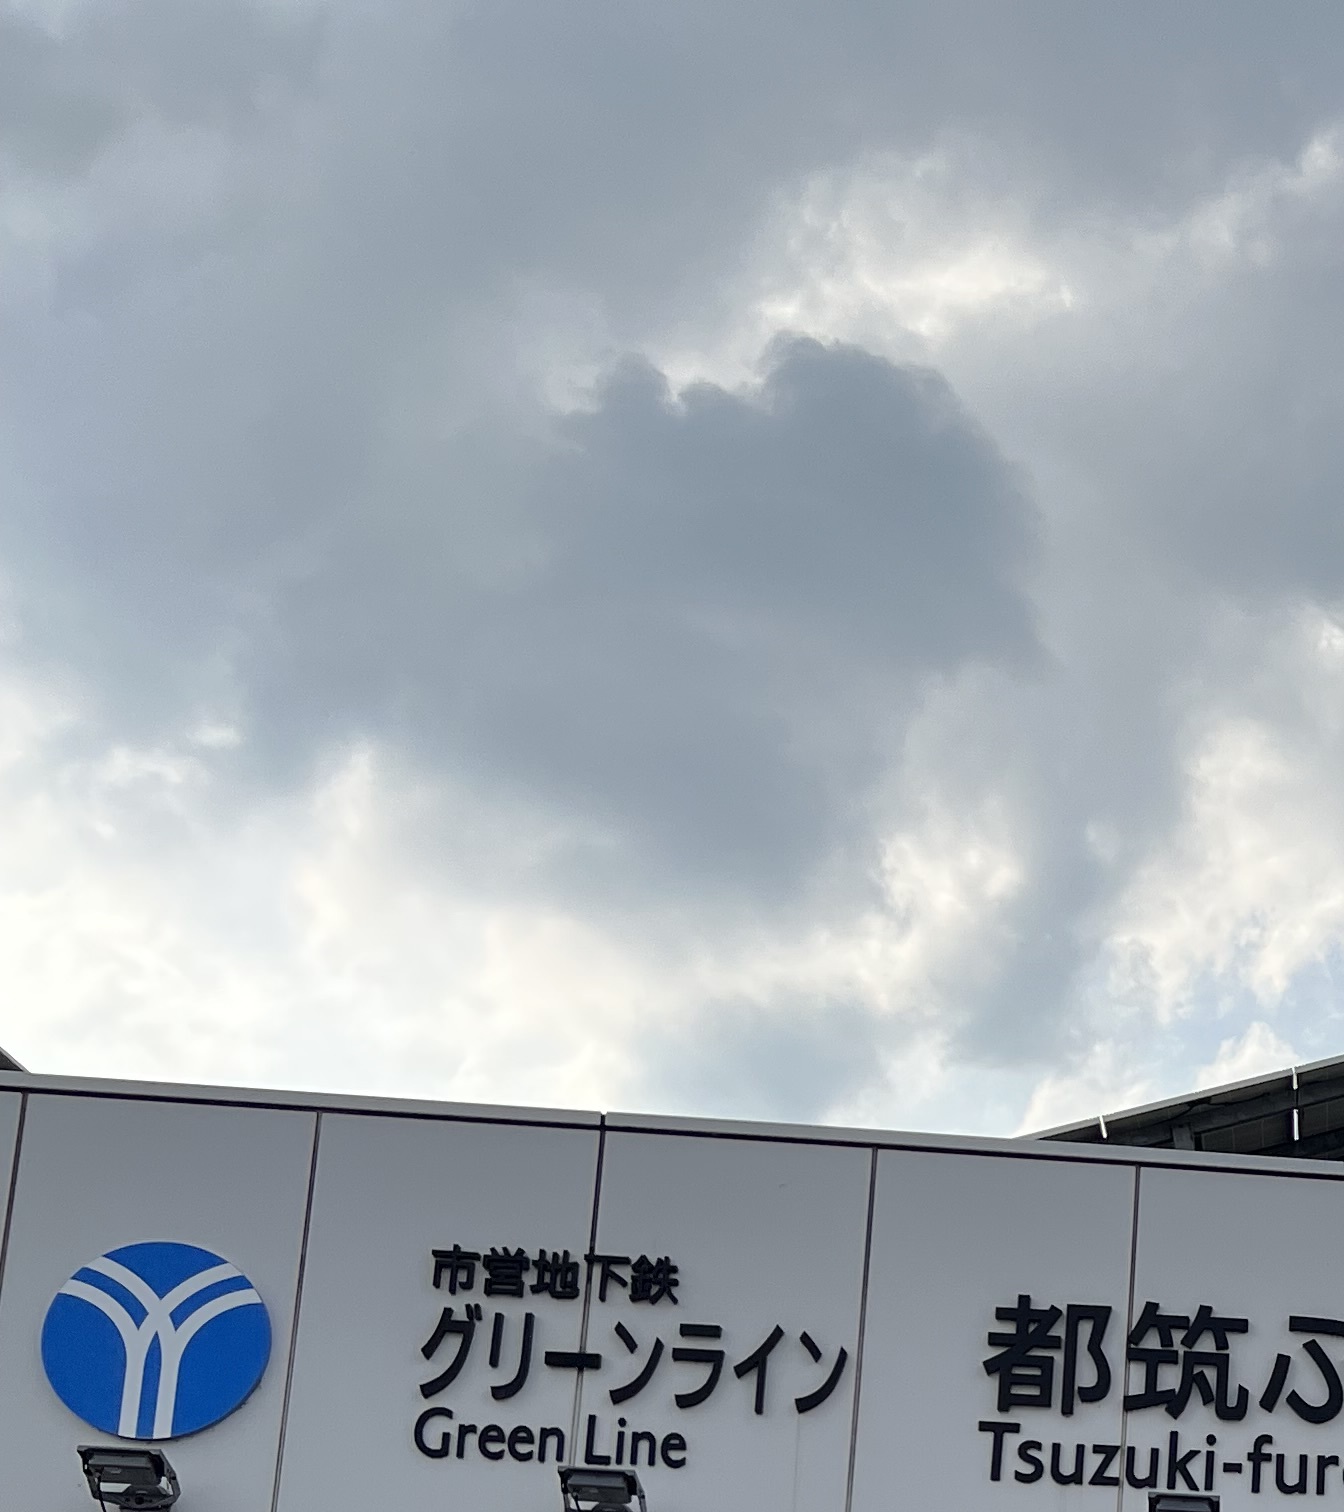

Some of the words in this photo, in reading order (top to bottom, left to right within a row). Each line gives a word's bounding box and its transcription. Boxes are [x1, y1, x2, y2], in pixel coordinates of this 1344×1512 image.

[431, 1243, 680, 1306] 市営地下鉄
[418, 1305, 849, 1416] グリーンライン
[412, 1406, 566, 1464] Green
[584, 1414, 688, 1470] Line
